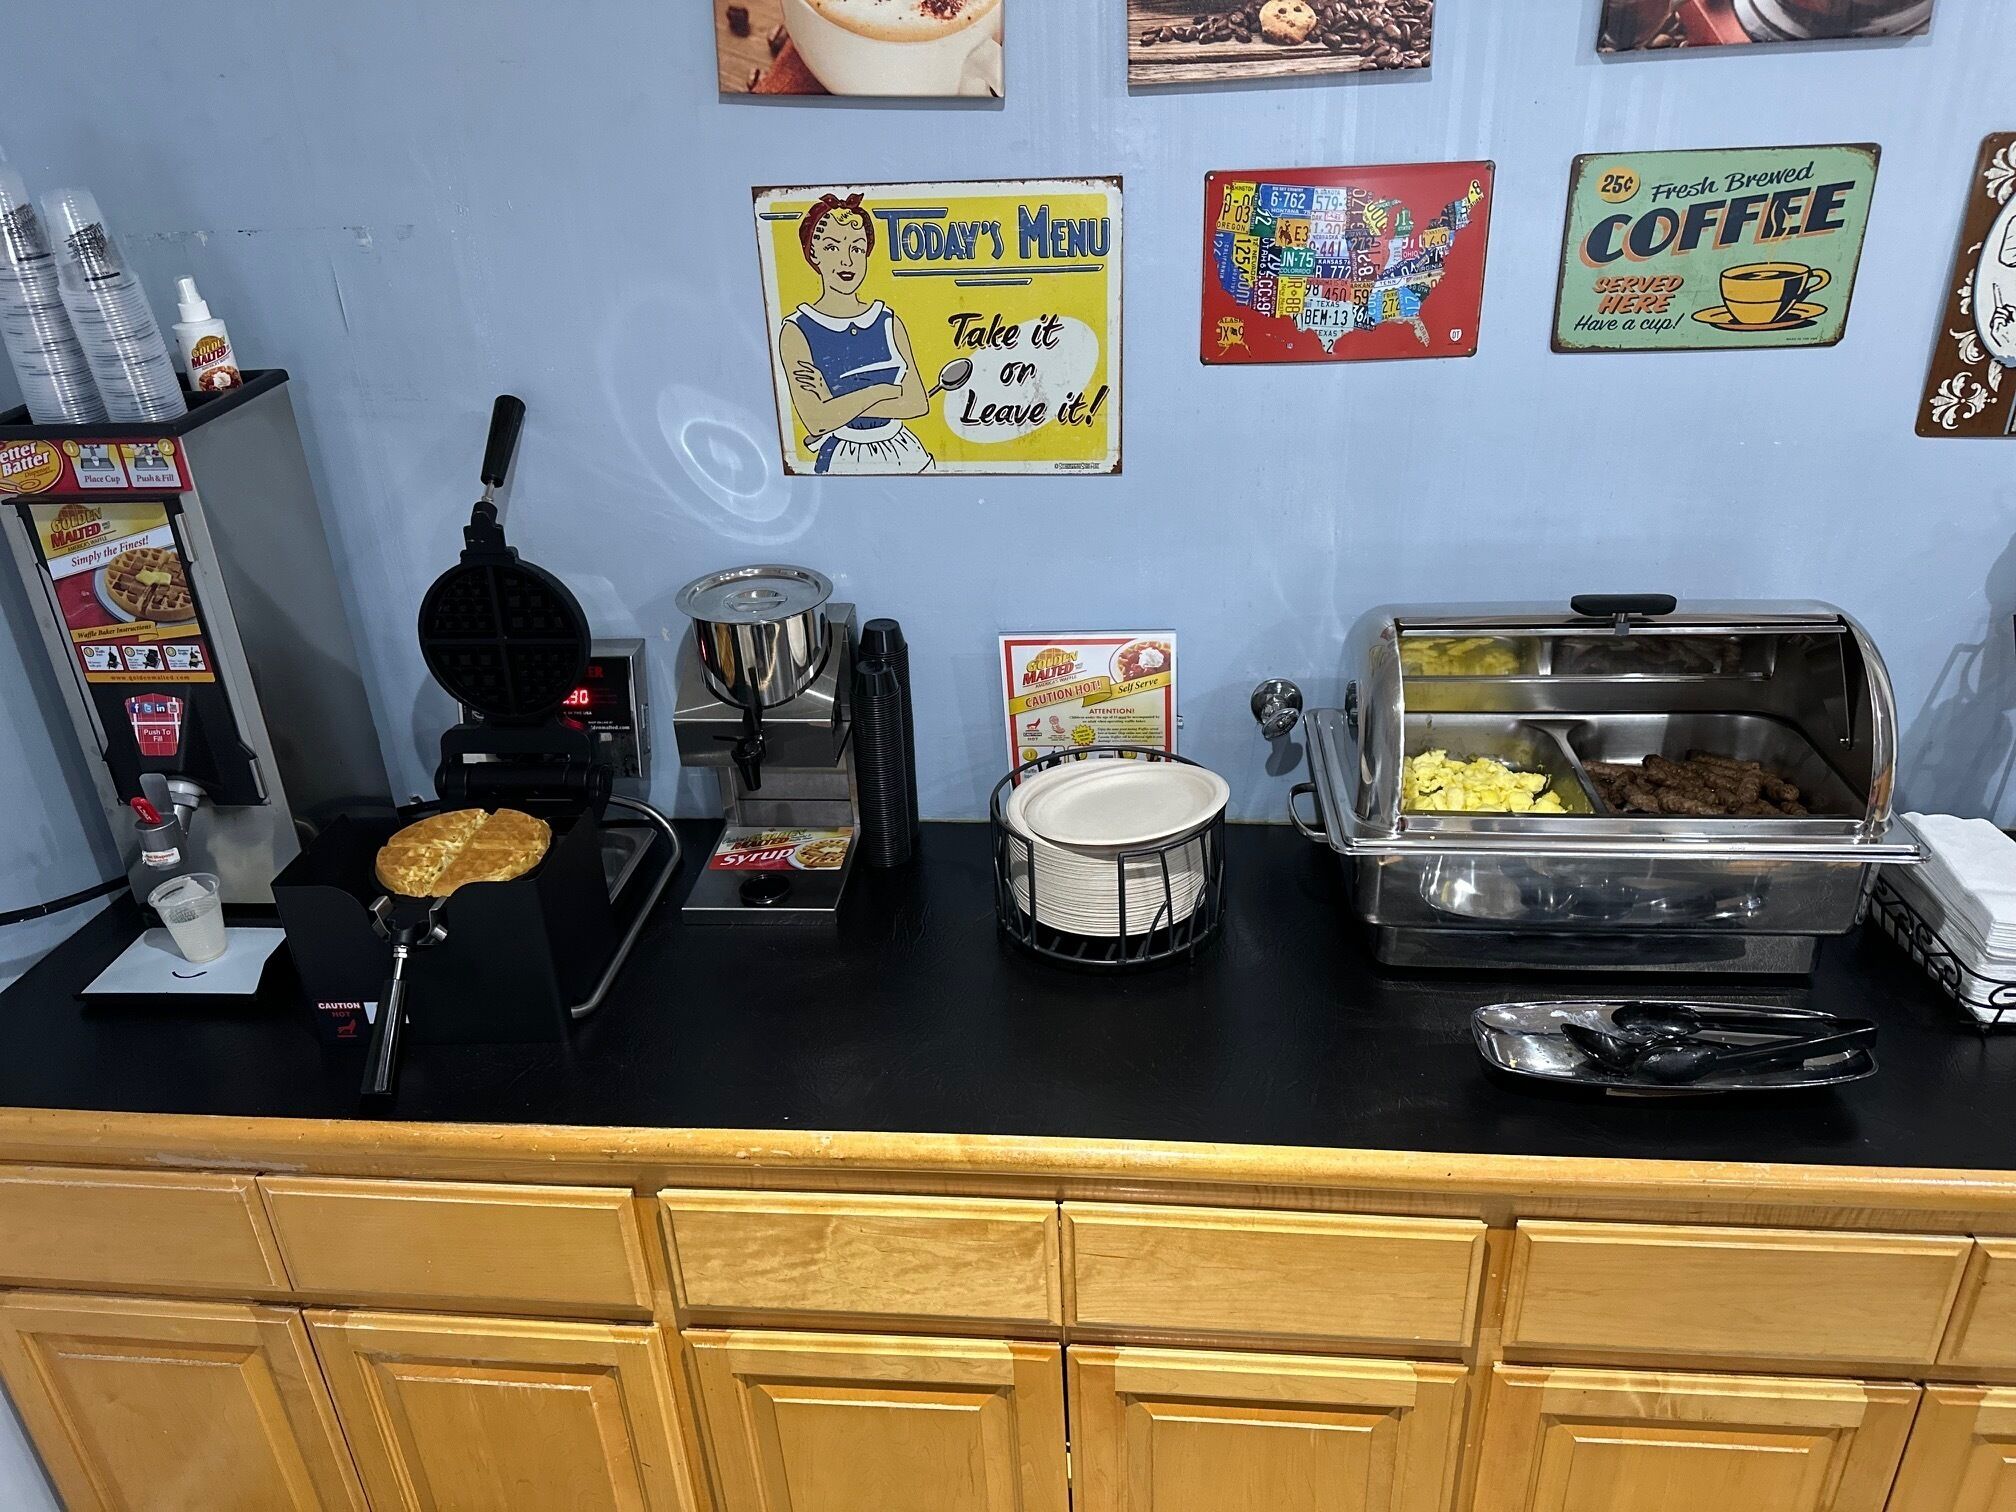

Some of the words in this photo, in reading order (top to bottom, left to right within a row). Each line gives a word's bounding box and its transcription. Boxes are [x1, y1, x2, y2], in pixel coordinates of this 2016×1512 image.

[1600, 174, 1634, 194] 25¢
[1651, 177, 1718, 202] Fresh
[1725, 161, 1814, 193] Brewed
[872, 208, 1005, 261] TODAY'S
[1018, 204, 1111, 260] MENU
[1217, 221, 1247, 231] OREGON
[1581, 180, 1855, 267] COFFEE
[1593, 275, 1684, 295] SERVED
[1598, 294, 1675, 315] HERE
[948, 312, 1020, 349] Take
[1031, 313, 1063, 348] it
[1573, 315, 1619, 332] Have
[1624, 318, 1636, 330] a
[1640, 313, 1685, 334] cup!
[999, 361, 1036, 385] or
[960, 390, 1046, 426] Leave
[1056, 385, 1109, 426] it!
[0, 441, 38, 463] etter
[1, 451, 50, 477] Batter
[84, 475, 104, 483] Place
[105, 475, 121, 484] Cup
[162, 474, 174, 482] Fill
[50, 507, 103, 533] GOLDEN
[50, 522, 102, 548] MALTED
[71, 550, 102, 568] Simply
[103, 545, 117, 557] the
[119, 535, 149, 553] Finest!
[77, 628, 97, 639] Waffle
[98, 627, 115, 636] Baker
[116, 623, 152, 634] Instructions
[1026, 650, 1079, 672] GOLDEN
[1022, 662, 1075, 686] MALTED
[1025, 689, 1073, 708] CAUTION
[1076, 681, 1102, 695] HOT!
[1118, 683, 1134, 694] Self
[1134, 678, 1159, 690] Serve
[318, 1002, 361, 1010] CAUTION
